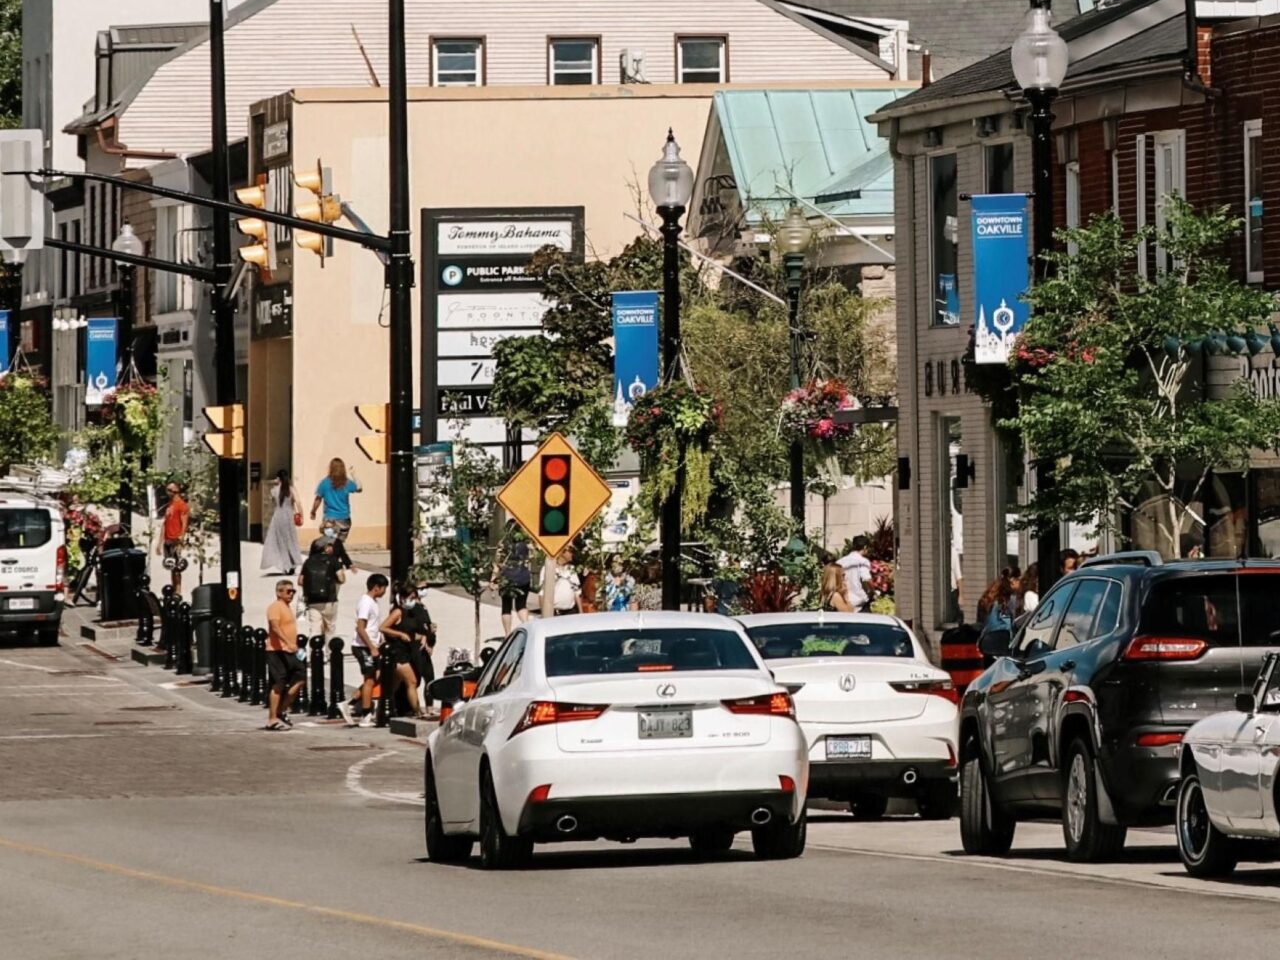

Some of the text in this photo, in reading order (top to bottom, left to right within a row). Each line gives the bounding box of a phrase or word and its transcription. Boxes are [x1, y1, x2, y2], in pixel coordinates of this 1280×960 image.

[976, 216, 1023, 224] DOWNTOWN
[448, 225, 561, 243] Tommy Bahama
[976, 224, 1023, 235] OAKVILLE
[466, 266, 525, 276] PUBLIC PARK
[616, 315, 655, 324] OAKVILLE
